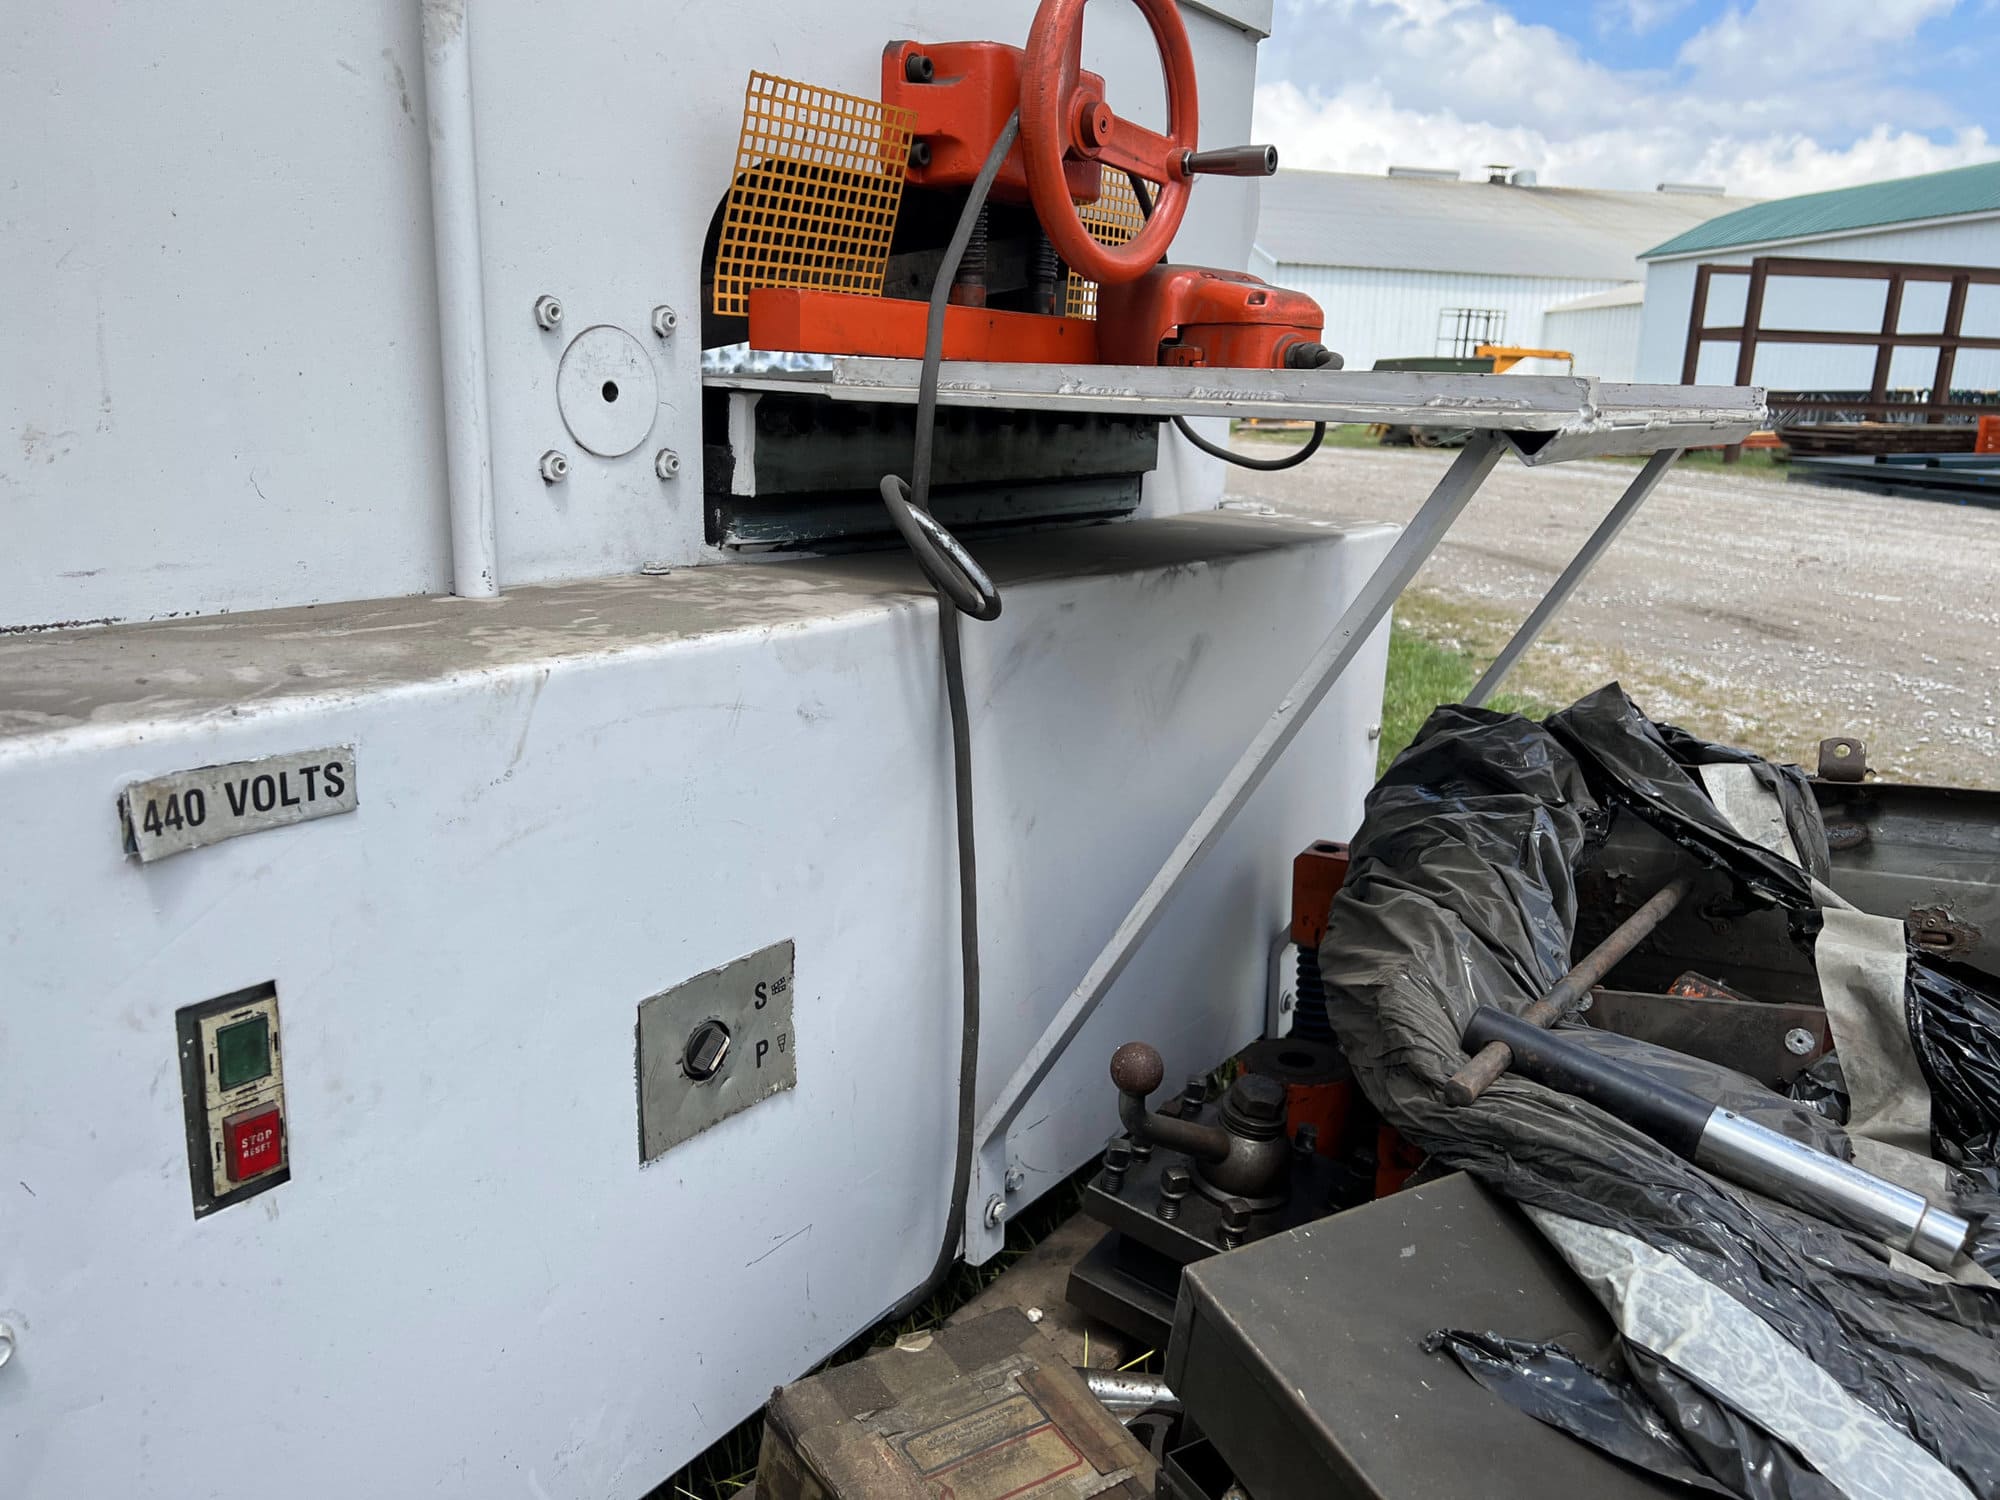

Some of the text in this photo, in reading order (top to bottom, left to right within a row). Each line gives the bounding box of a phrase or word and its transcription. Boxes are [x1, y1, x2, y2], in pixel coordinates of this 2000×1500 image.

[143, 761, 345, 837] 440 VOLTS
[754, 981, 767, 1010] S
[755, 1039, 769, 1068] P
[241, 1129, 272, 1149] STOP
[243, 1141, 271, 1158] RESET
